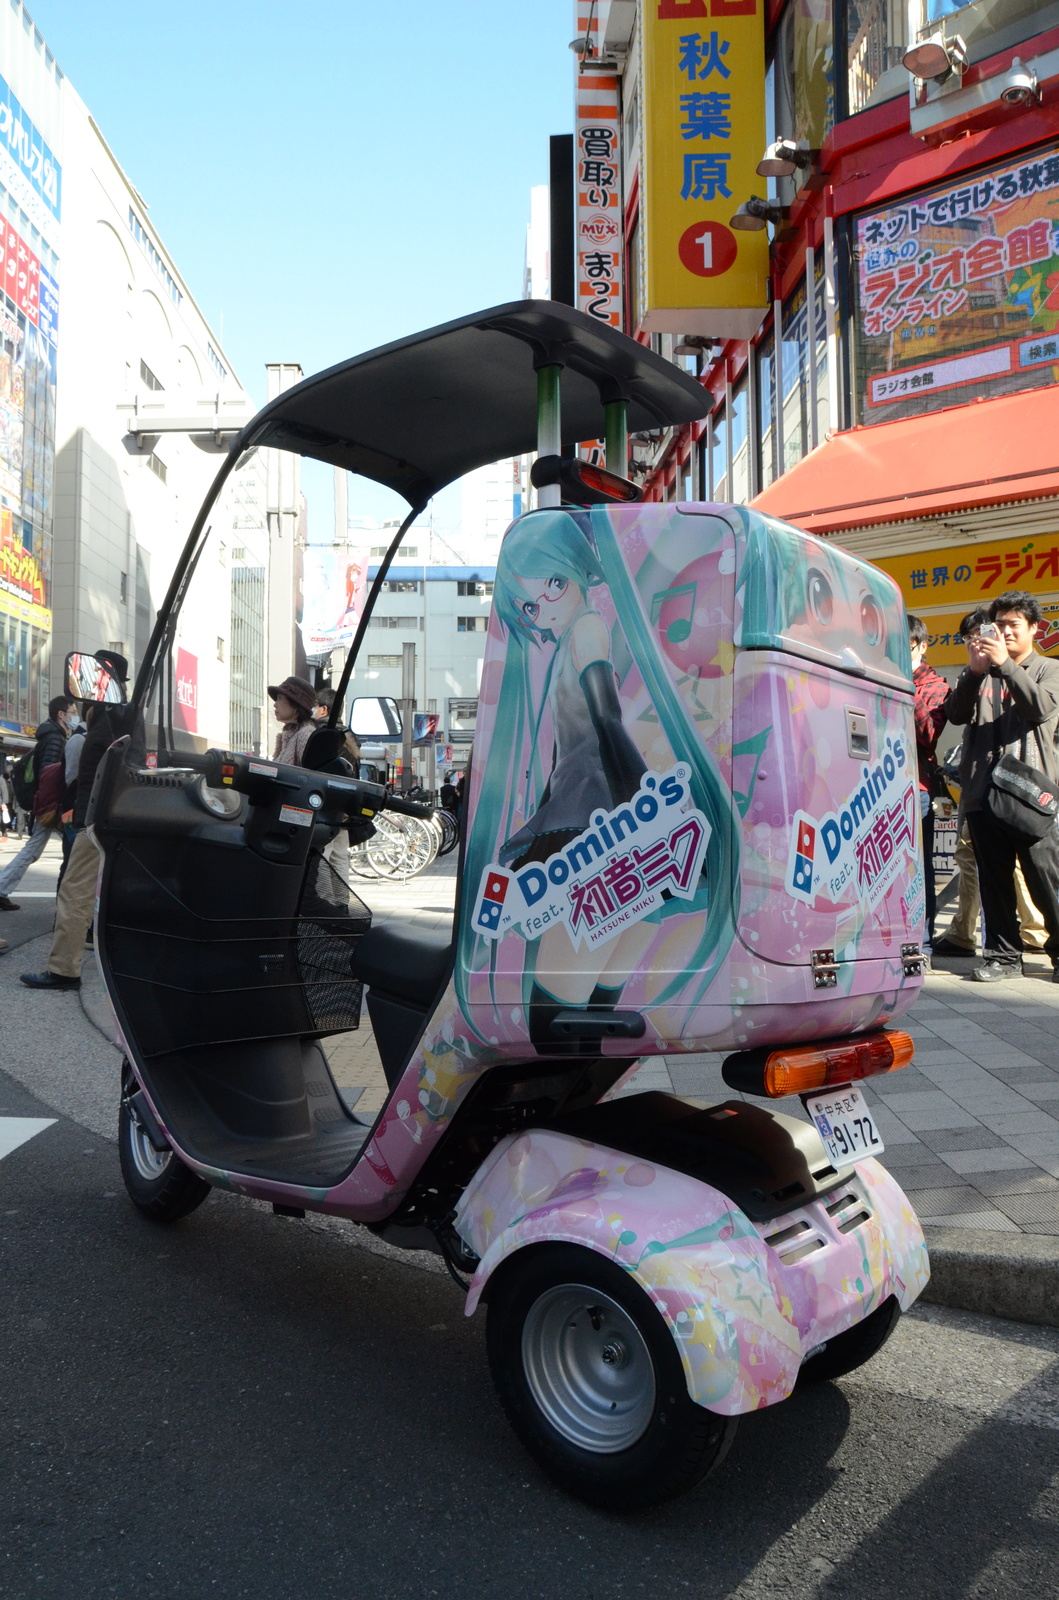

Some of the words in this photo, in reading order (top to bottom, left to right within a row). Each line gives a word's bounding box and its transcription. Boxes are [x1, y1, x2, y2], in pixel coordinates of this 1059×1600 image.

[678, 31, 733, 202] 秋葉原
[581, 127, 615, 208] 買取り
[694, 231, 713, 269] 1
[864, 220, 1050, 309] ラジオ会館
[865, 241, 917, 271] 世界の
[584, 252, 612, 319] まっく
[866, 290, 967, 334] オンライン
[1028, 342, 1057, 360] 検索
[877, 372, 934, 396] ラジオ会館
[855, 782, 916, 892] 初音ミク
[569, 818, 703, 929] 初音ミク
[829, 862, 854, 898] feat.
[869, 870, 890, 904] HATSUNE
[889, 854, 903, 876] MIKU
[905, 872, 924, 906] HATS
[525, 903, 565, 935] feat.
[590, 911, 631, 942] HATSUNE
[631, 894, 656, 916] MIKU
[824, 1098, 854, 1117] 中央区
[827, 1139, 840, 1158] け
